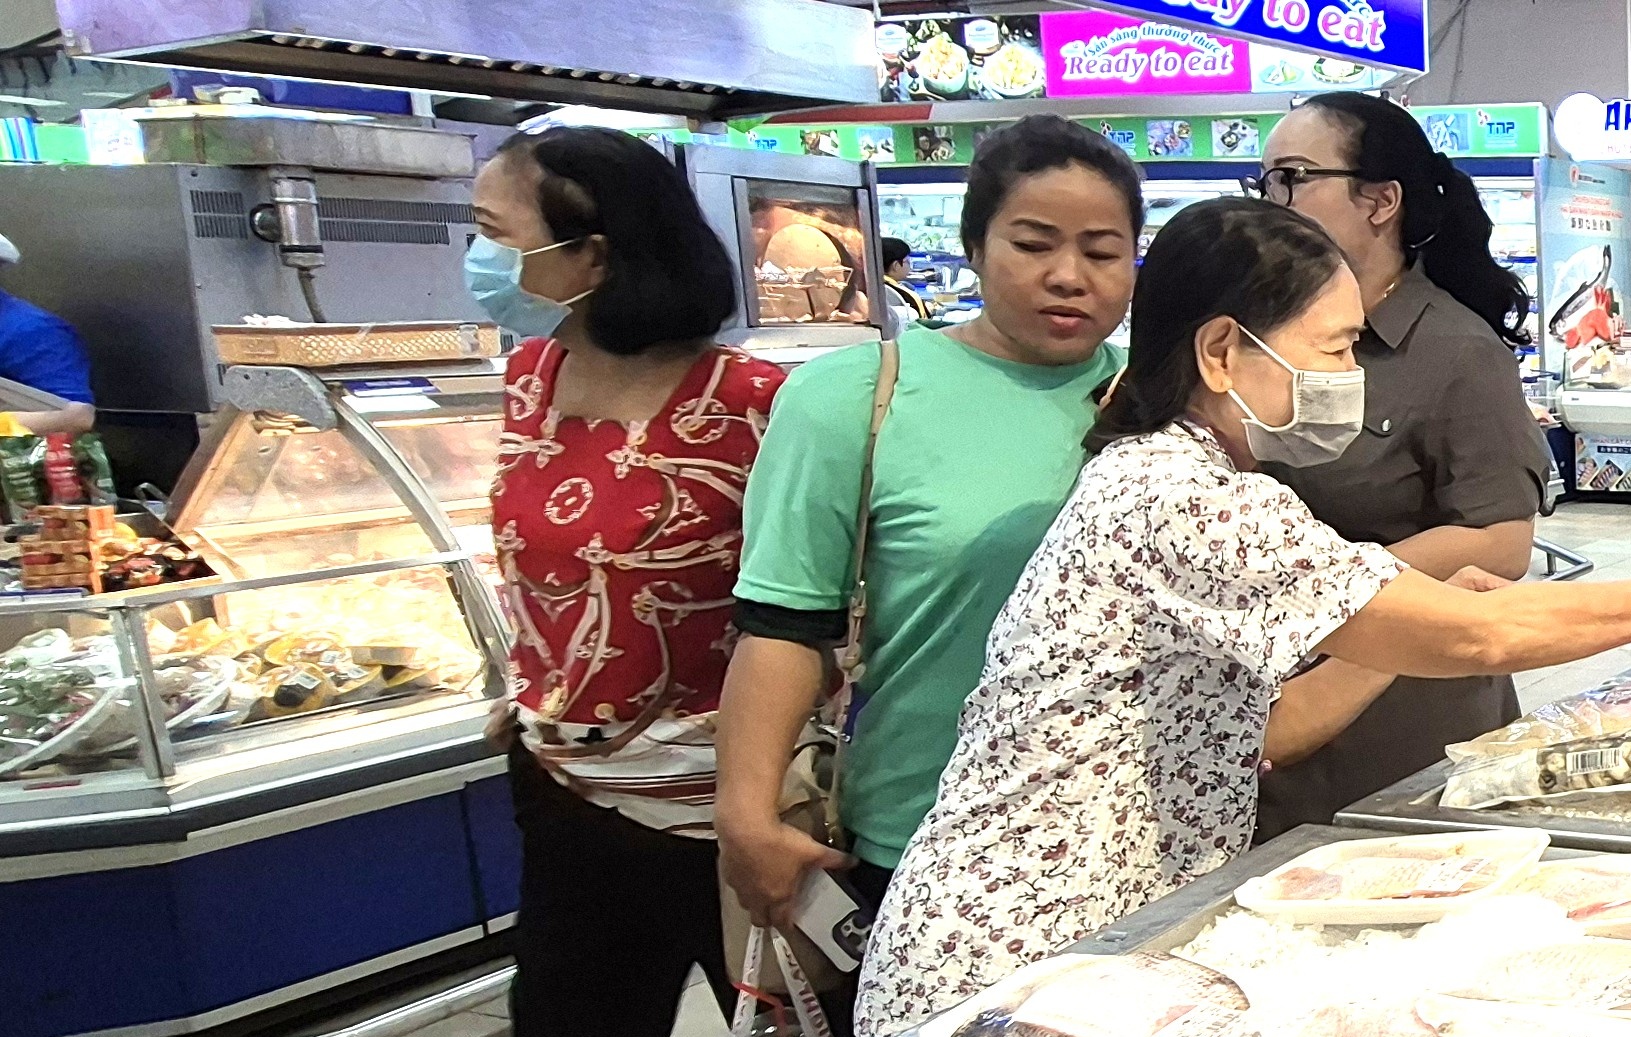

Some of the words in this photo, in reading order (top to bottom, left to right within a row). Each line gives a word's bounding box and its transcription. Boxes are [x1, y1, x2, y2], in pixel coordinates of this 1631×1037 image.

[1321, 12, 1384, 48] eat
[1069, 52, 1145, 78] Ready
[1154, 53, 1178, 71] to
[1188, 51, 1229, 71] eat
